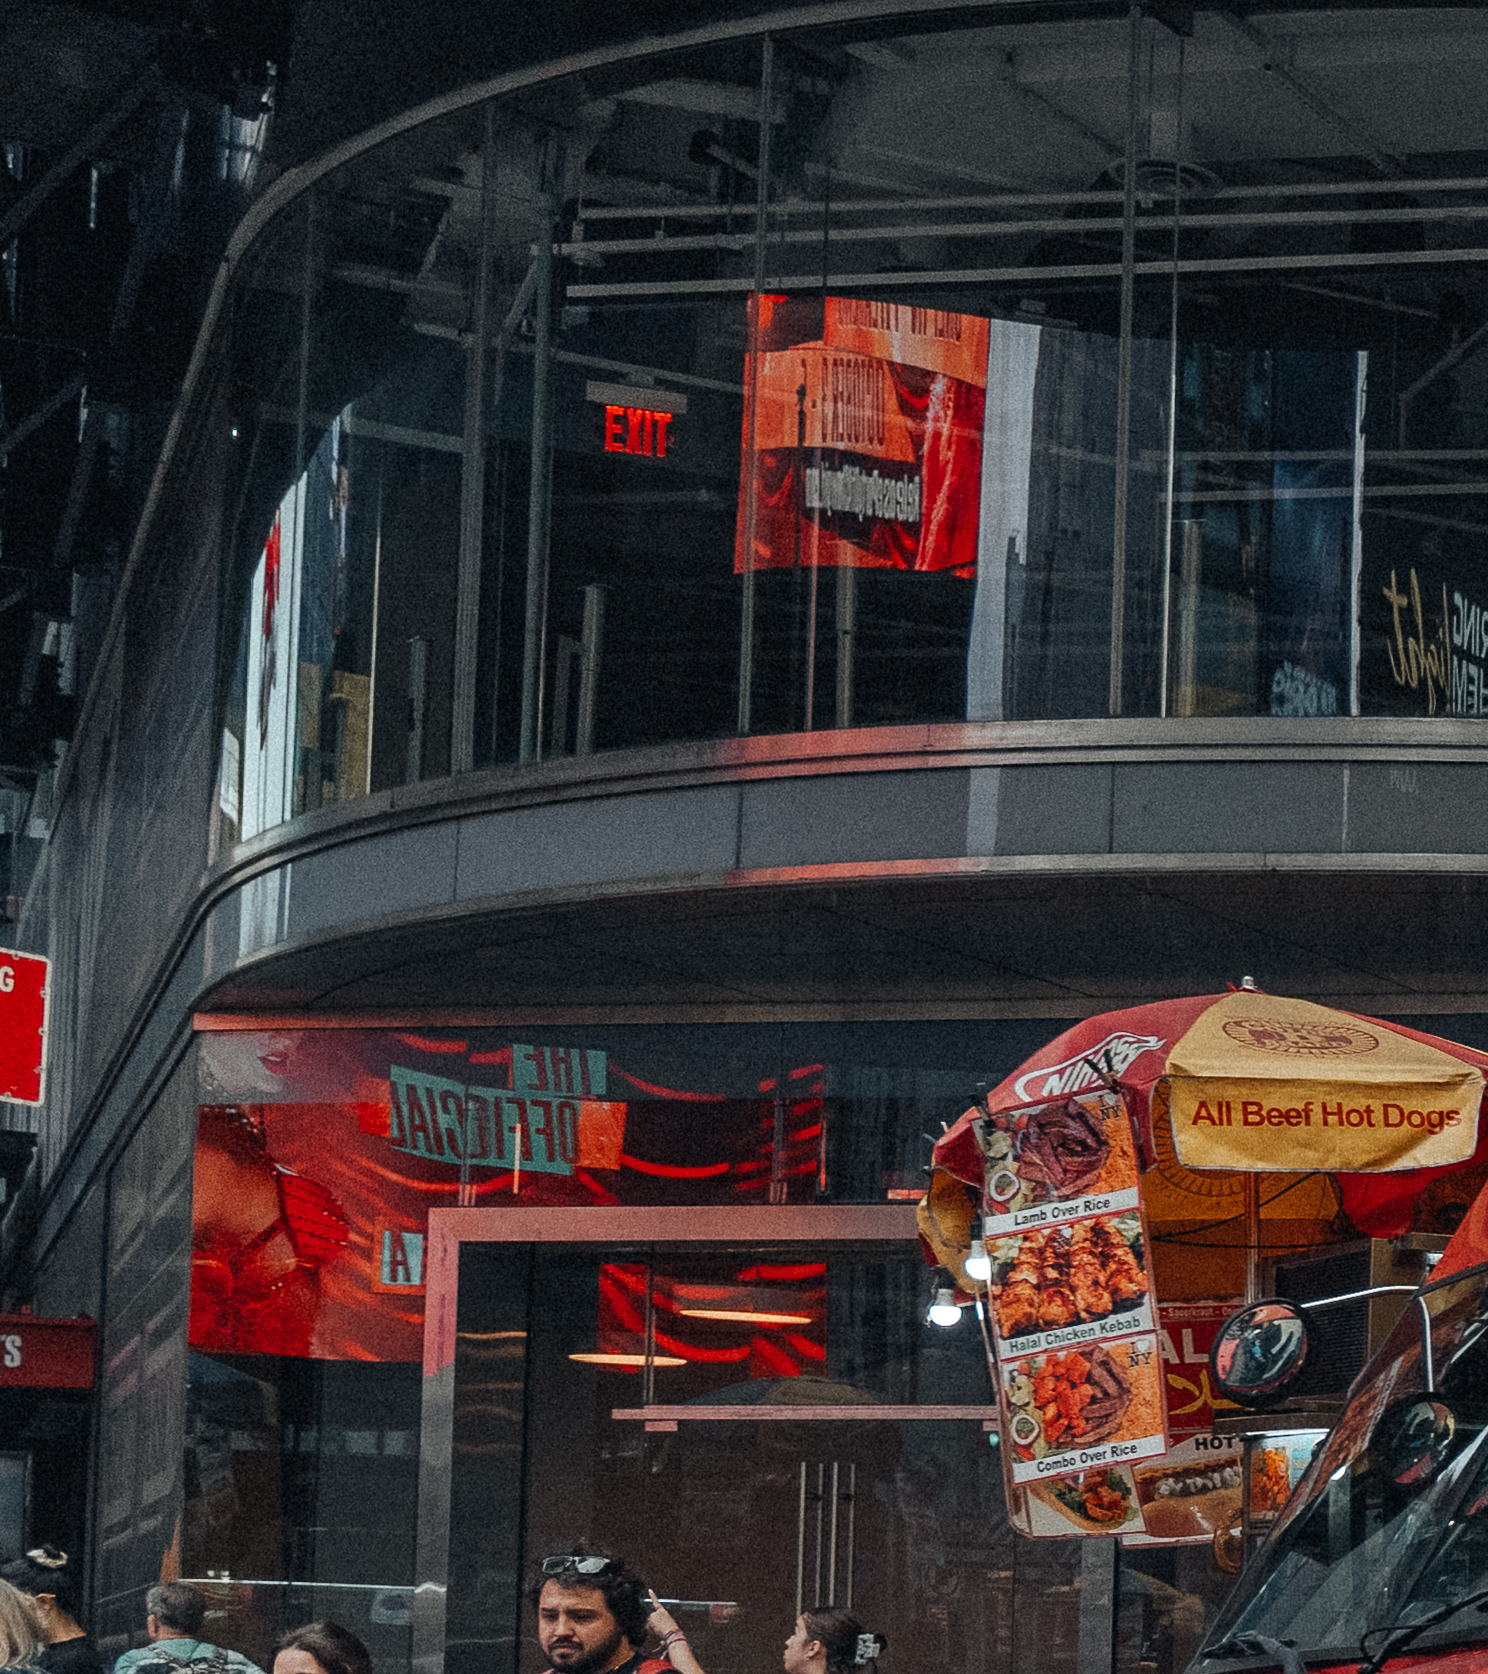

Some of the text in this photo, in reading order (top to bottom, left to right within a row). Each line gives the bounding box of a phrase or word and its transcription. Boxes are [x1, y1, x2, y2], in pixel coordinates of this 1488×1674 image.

[605, 406, 673, 457] EXIT
[1191, 1101, 1462, 1135] All Beef Hot Dogs
[1014, 1197, 1111, 1226] Lamb Over Rice
[1009, 1316, 1141, 1353] Halal Chicken Kebab
[1129, 1351, 1152, 1368] NY
[1037, 1444, 1138, 1473] Combo Over Rice
[1195, 1438, 1235, 1451] HOT
